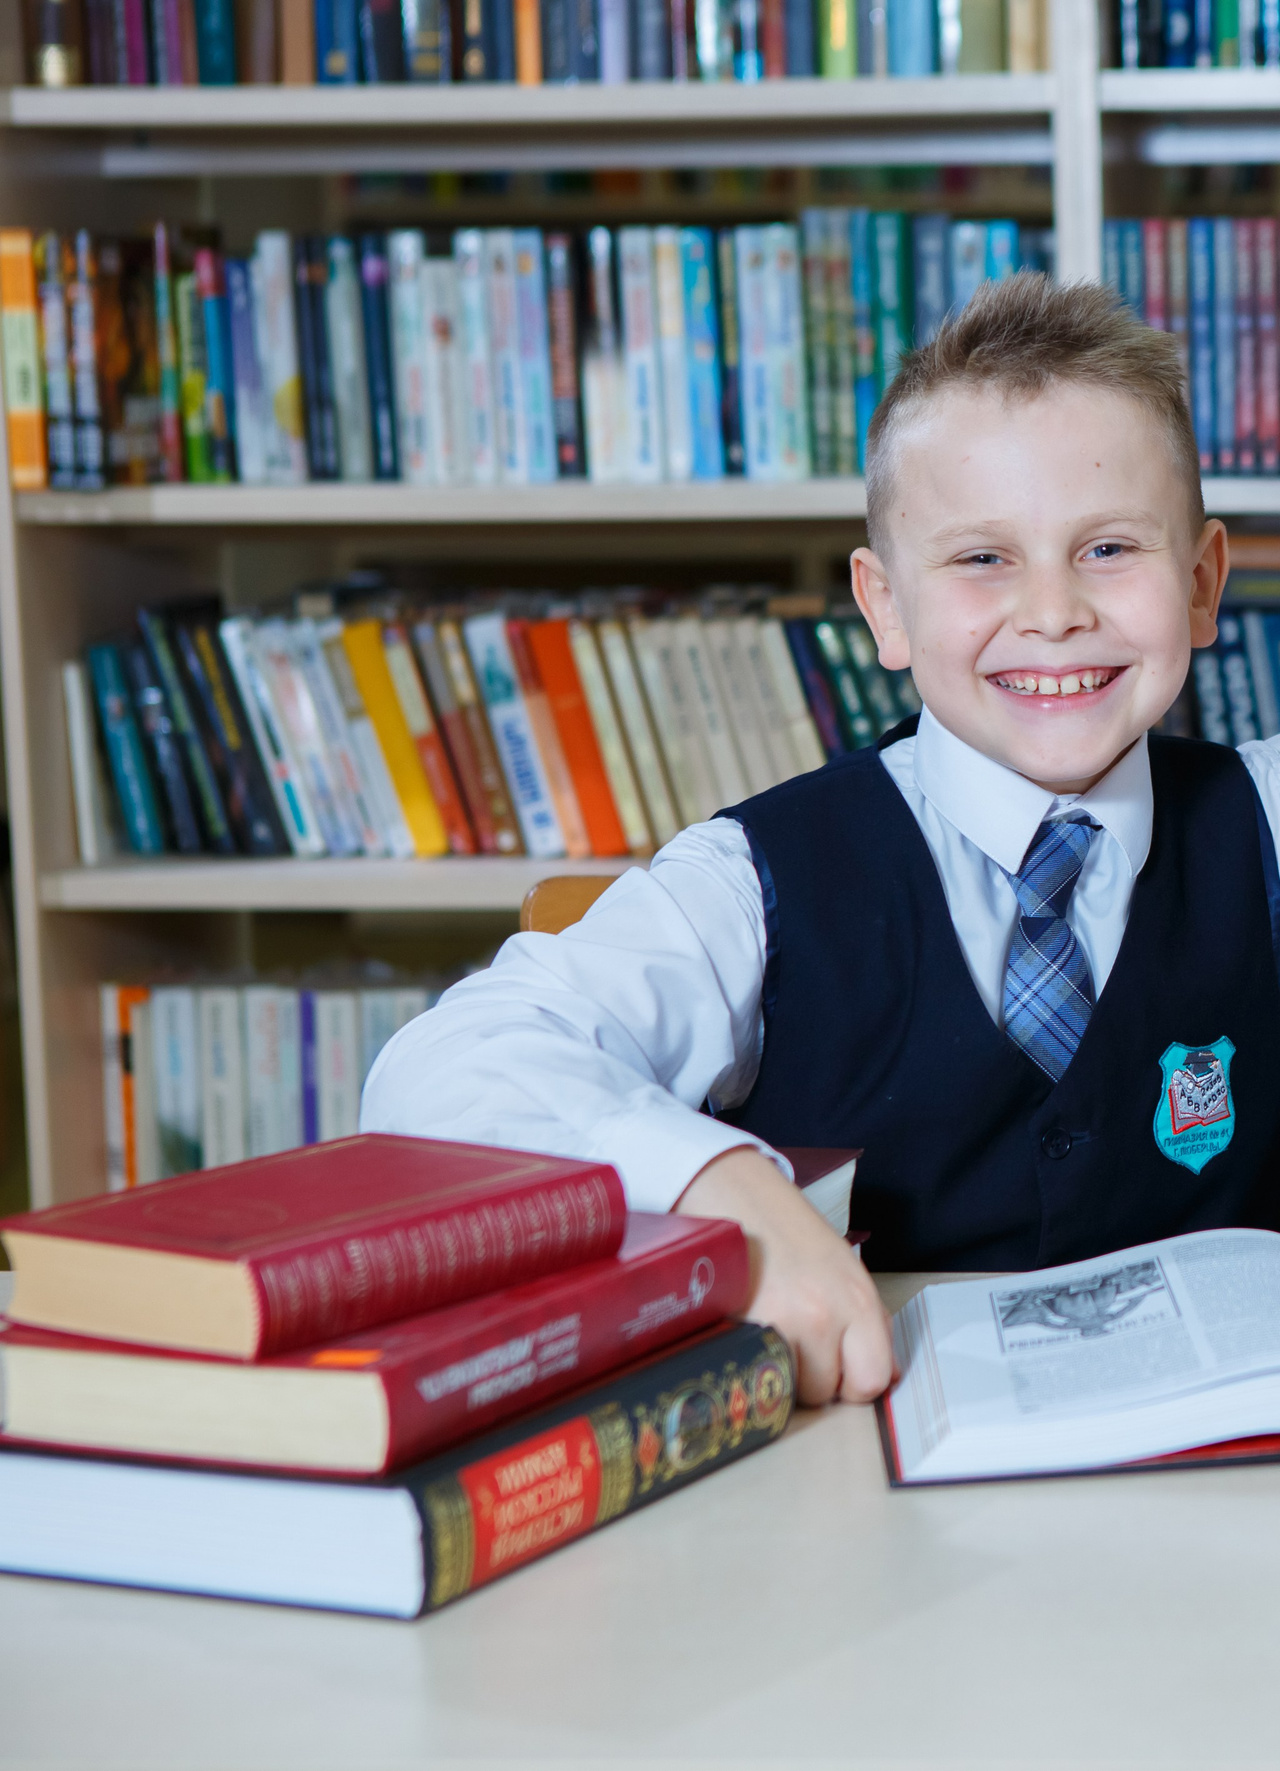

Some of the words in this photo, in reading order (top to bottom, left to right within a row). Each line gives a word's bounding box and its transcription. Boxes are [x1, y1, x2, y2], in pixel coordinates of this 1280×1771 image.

[1164, 1131, 1208, 1148] ГИМНАЗИЯ
[489, 1498, 585, 1568] ИСТОРИЯ
[493, 1465, 584, 1534] РУССКОЙ
